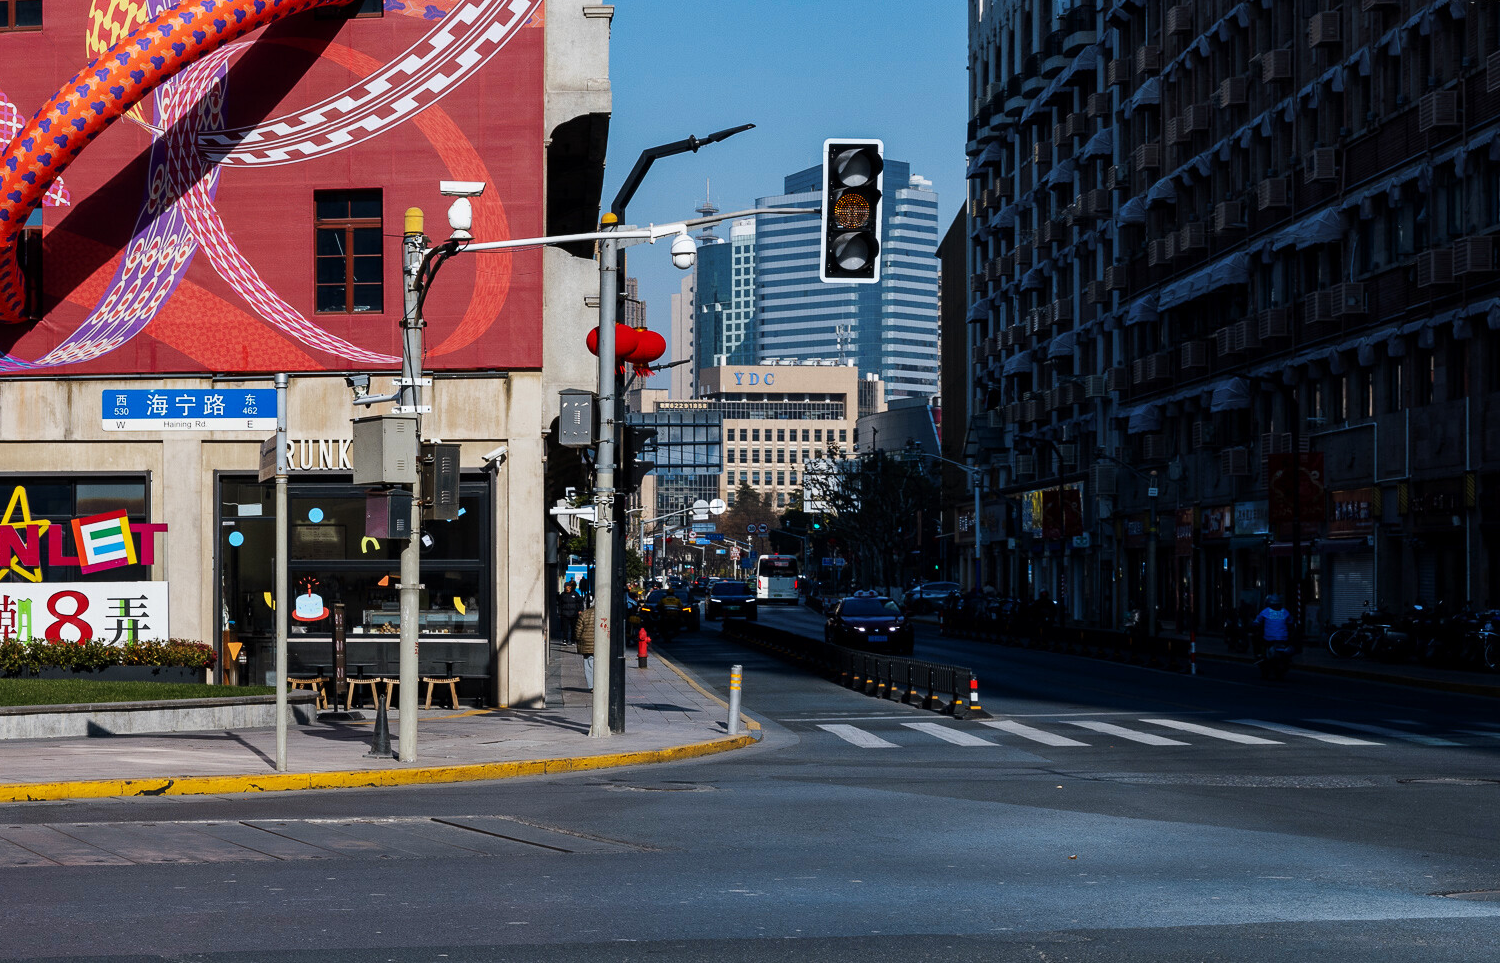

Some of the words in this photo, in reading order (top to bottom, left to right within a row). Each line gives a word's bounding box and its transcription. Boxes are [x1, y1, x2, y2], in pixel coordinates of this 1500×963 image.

[734, 372, 775, 386] YDC
[116, 394, 127, 406] 西
[146, 394, 226, 416] 海宁路
[244, 394, 256, 406] 东
[114, 407, 129, 416] 530
[243, 406, 258, 415] 462
[116, 421, 126, 429] W
[163, 420, 192, 430] Haining
[247, 420, 254, 428] E
